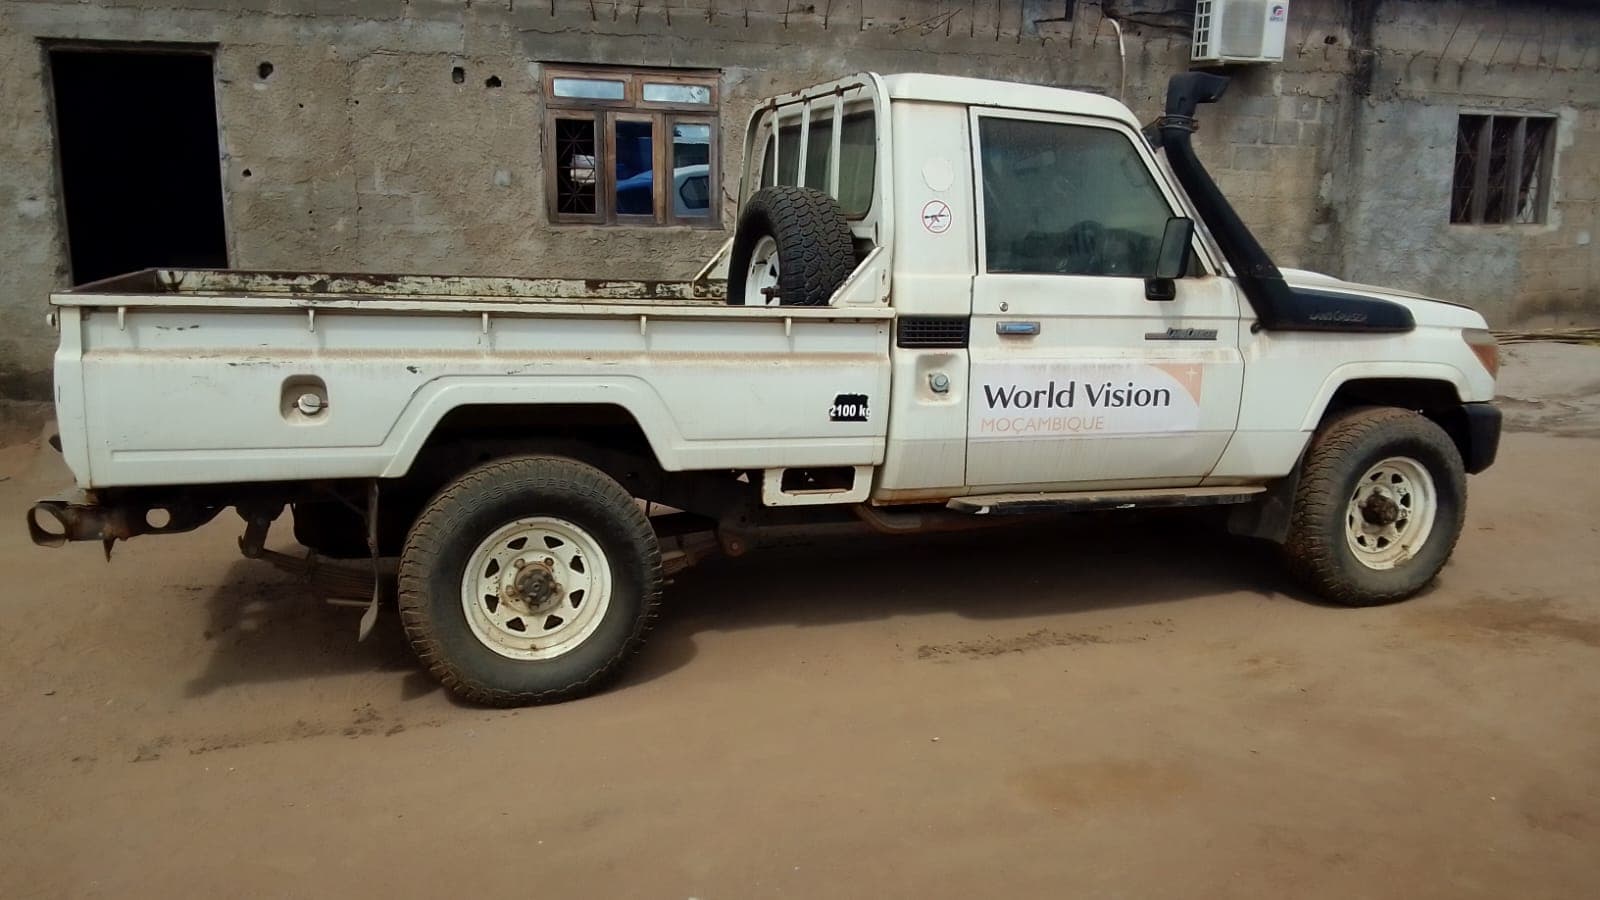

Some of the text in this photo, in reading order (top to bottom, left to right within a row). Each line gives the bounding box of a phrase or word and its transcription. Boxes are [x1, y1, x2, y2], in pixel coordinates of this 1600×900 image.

[983, 381, 1171, 409] World Vision
[829, 404, 857, 417] 2100
[980, 416, 1105, 433] MOÇAMBIQUE
